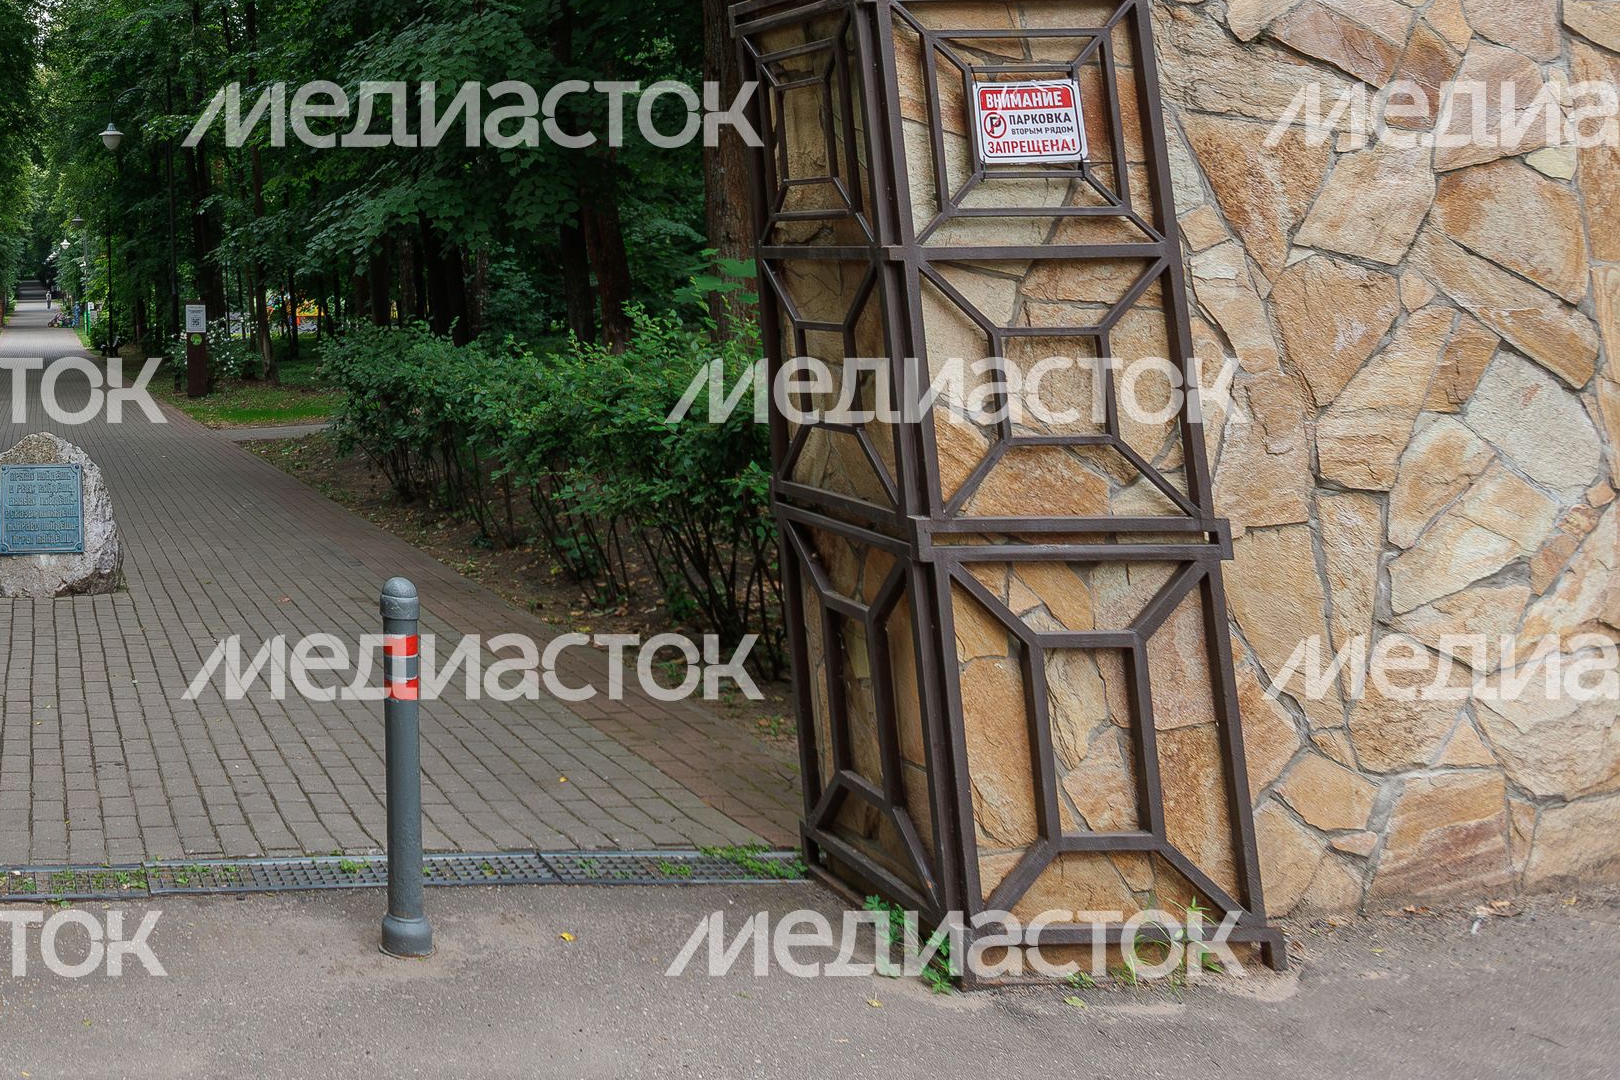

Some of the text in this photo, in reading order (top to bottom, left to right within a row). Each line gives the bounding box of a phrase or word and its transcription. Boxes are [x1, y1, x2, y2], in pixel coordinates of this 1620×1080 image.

[985, 90, 1063, 109] ВНИМАНИЕ
[1009, 112, 1072, 125] ПАРКОВКА
[1011, 126, 1074, 135] ВТОРЫМ РЯДОМ
[987, 138, 1077, 154] ЗАПРЕЩЕНА!
